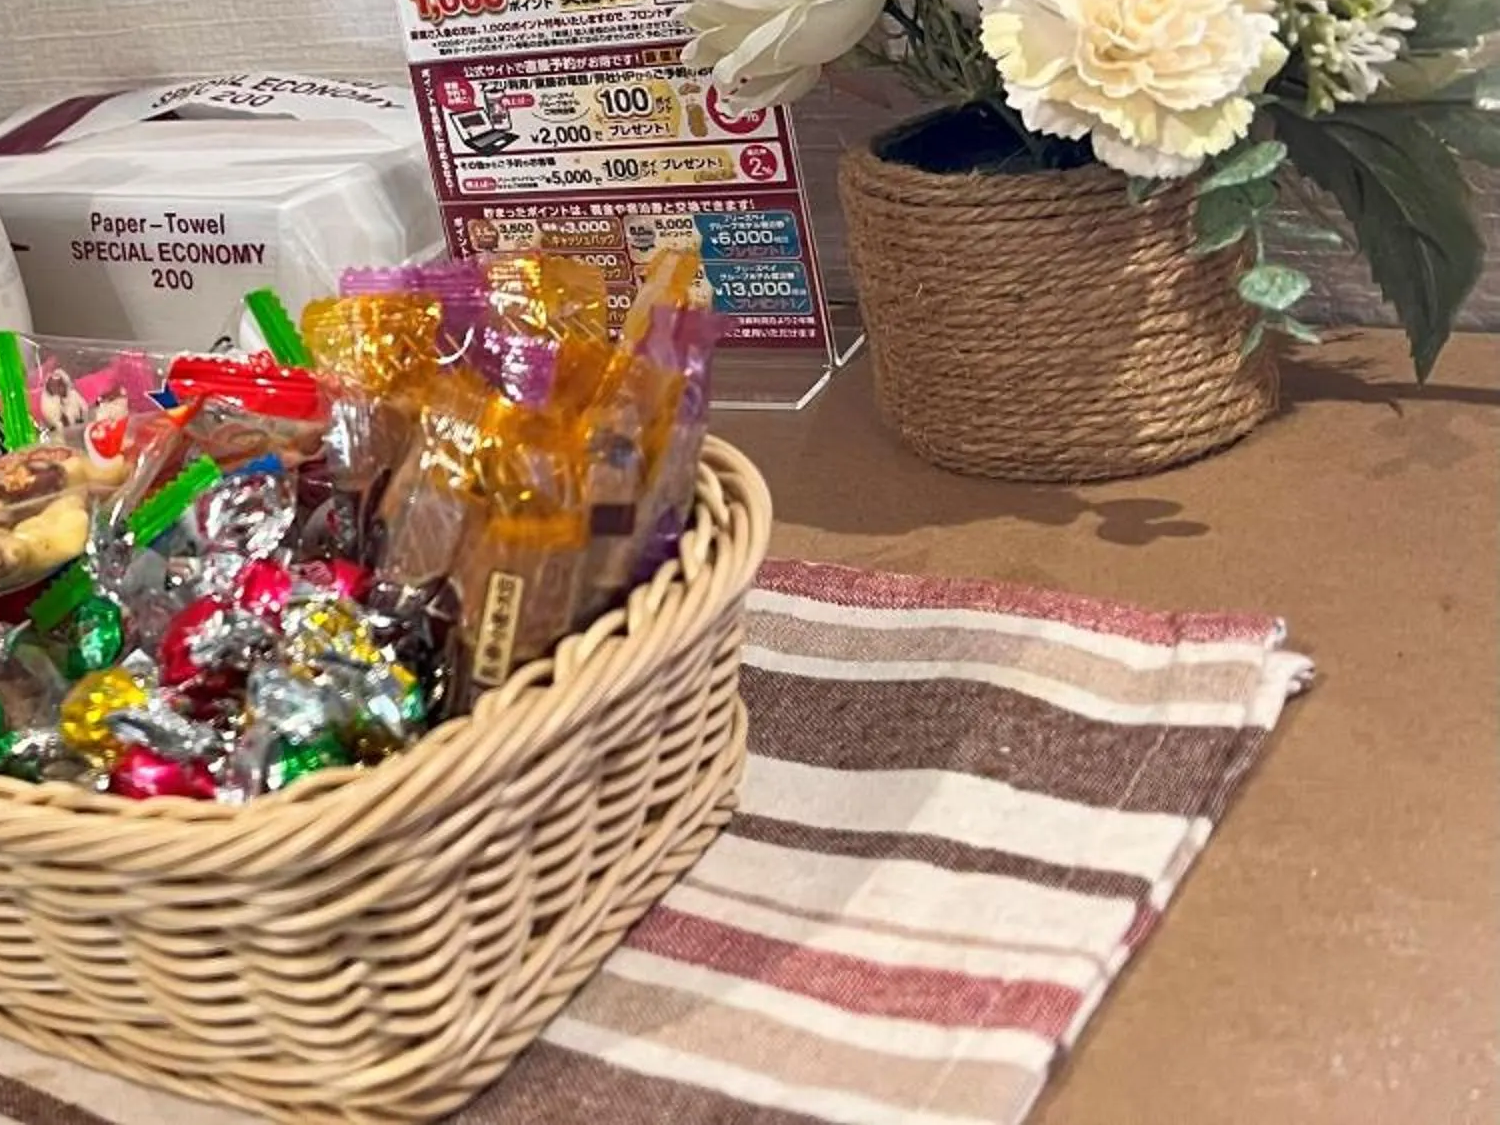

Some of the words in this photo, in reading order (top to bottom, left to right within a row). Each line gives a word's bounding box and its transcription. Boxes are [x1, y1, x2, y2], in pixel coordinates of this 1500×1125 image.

[210, 88, 275, 108] 200
[252, 75, 406, 110] ECONOMY
[599, 87, 650, 117] 100
[602, 158, 639, 179] 100
[71, 240, 154, 263] SPECIAL
[158, 241, 266, 265] ECONOMY
[151, 268, 194, 291] 200
